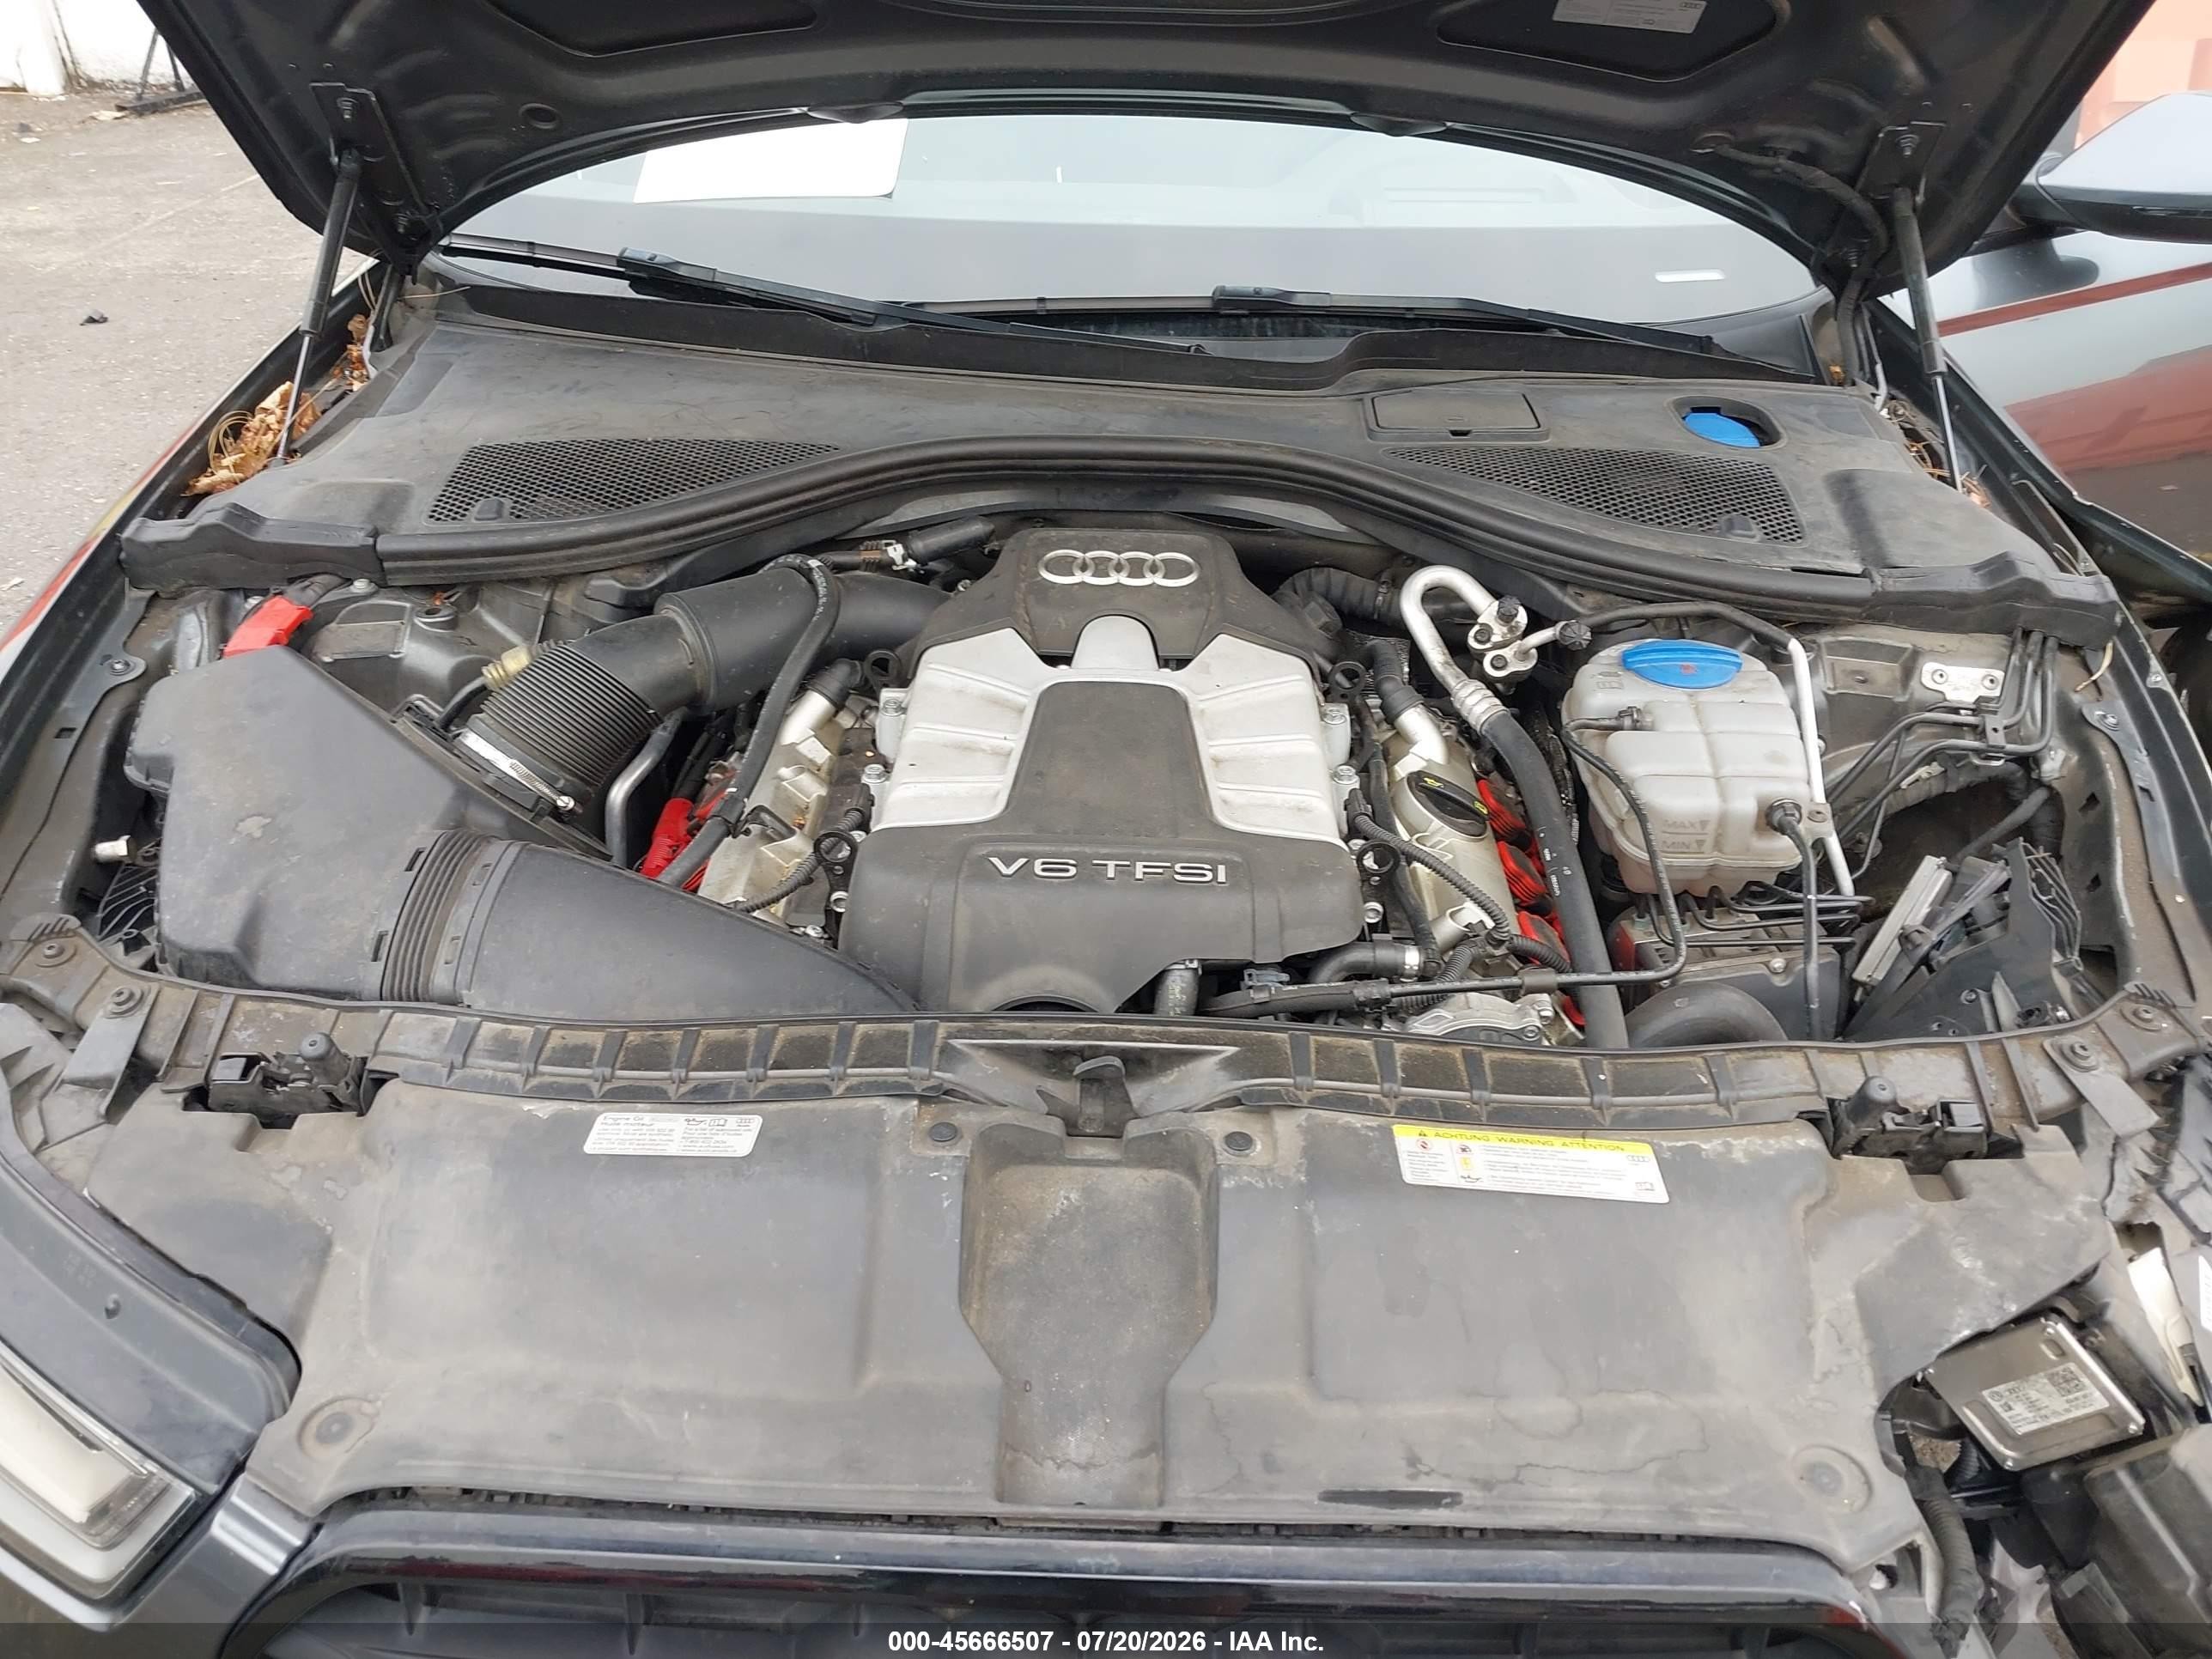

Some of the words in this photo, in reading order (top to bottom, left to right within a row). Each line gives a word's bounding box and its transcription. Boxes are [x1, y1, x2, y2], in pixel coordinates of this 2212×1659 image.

[1662, 818, 1698, 830] MAX
[1662, 840, 1692, 850] MIN
[988, 857, 1079, 879] V6
[1091, 860, 1229, 884] TFSI
[1433, 1132, 1491, 1142] ACHTUNG
[1496, 1136, 1554, 1146] WARNING
[1561, 1140, 1626, 1152] ATTENTION
